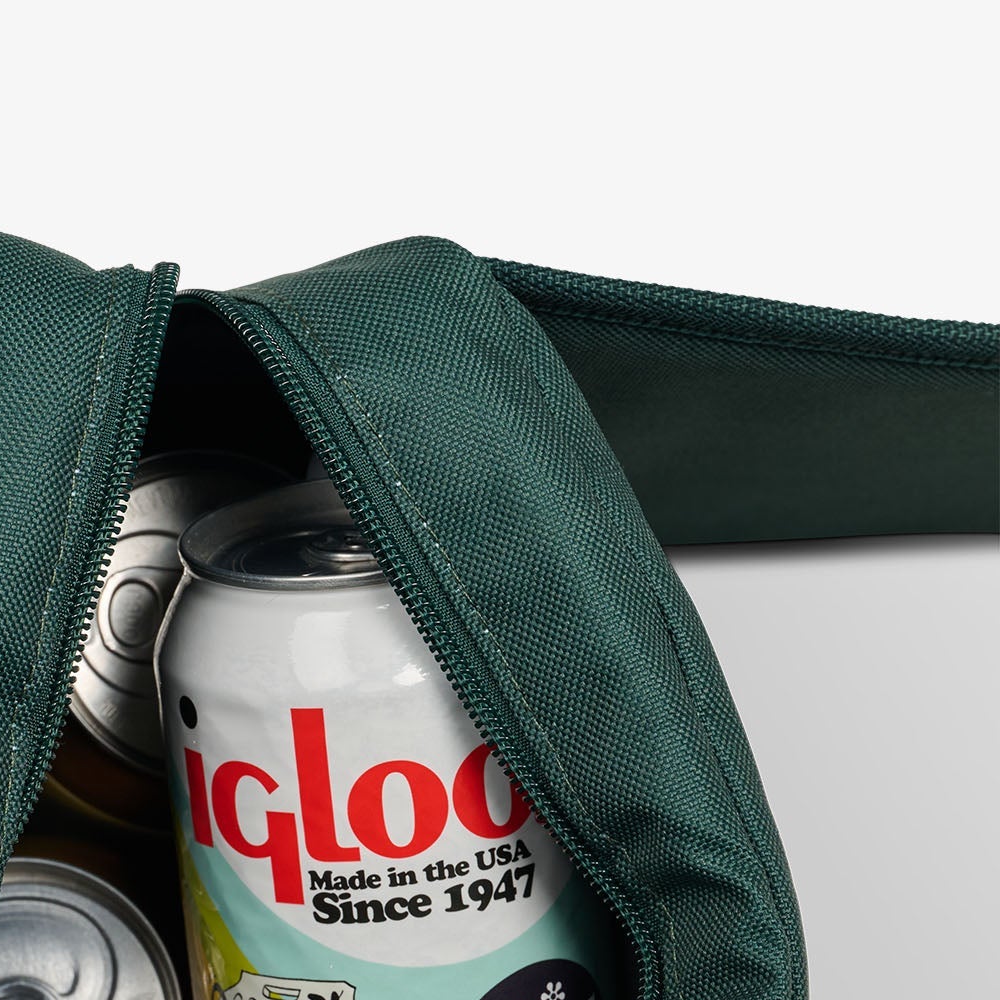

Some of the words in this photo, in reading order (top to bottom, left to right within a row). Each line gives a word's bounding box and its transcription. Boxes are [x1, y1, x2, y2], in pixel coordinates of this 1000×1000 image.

[179, 695, 535, 905] igloo
[308, 870, 382, 891] Made
[387, 867, 417, 887] in
[423, 860, 470, 882] the
[475, 839, 532, 871] USA
[312, 891, 432, 924] Since
[444, 863, 535, 912] 1947
